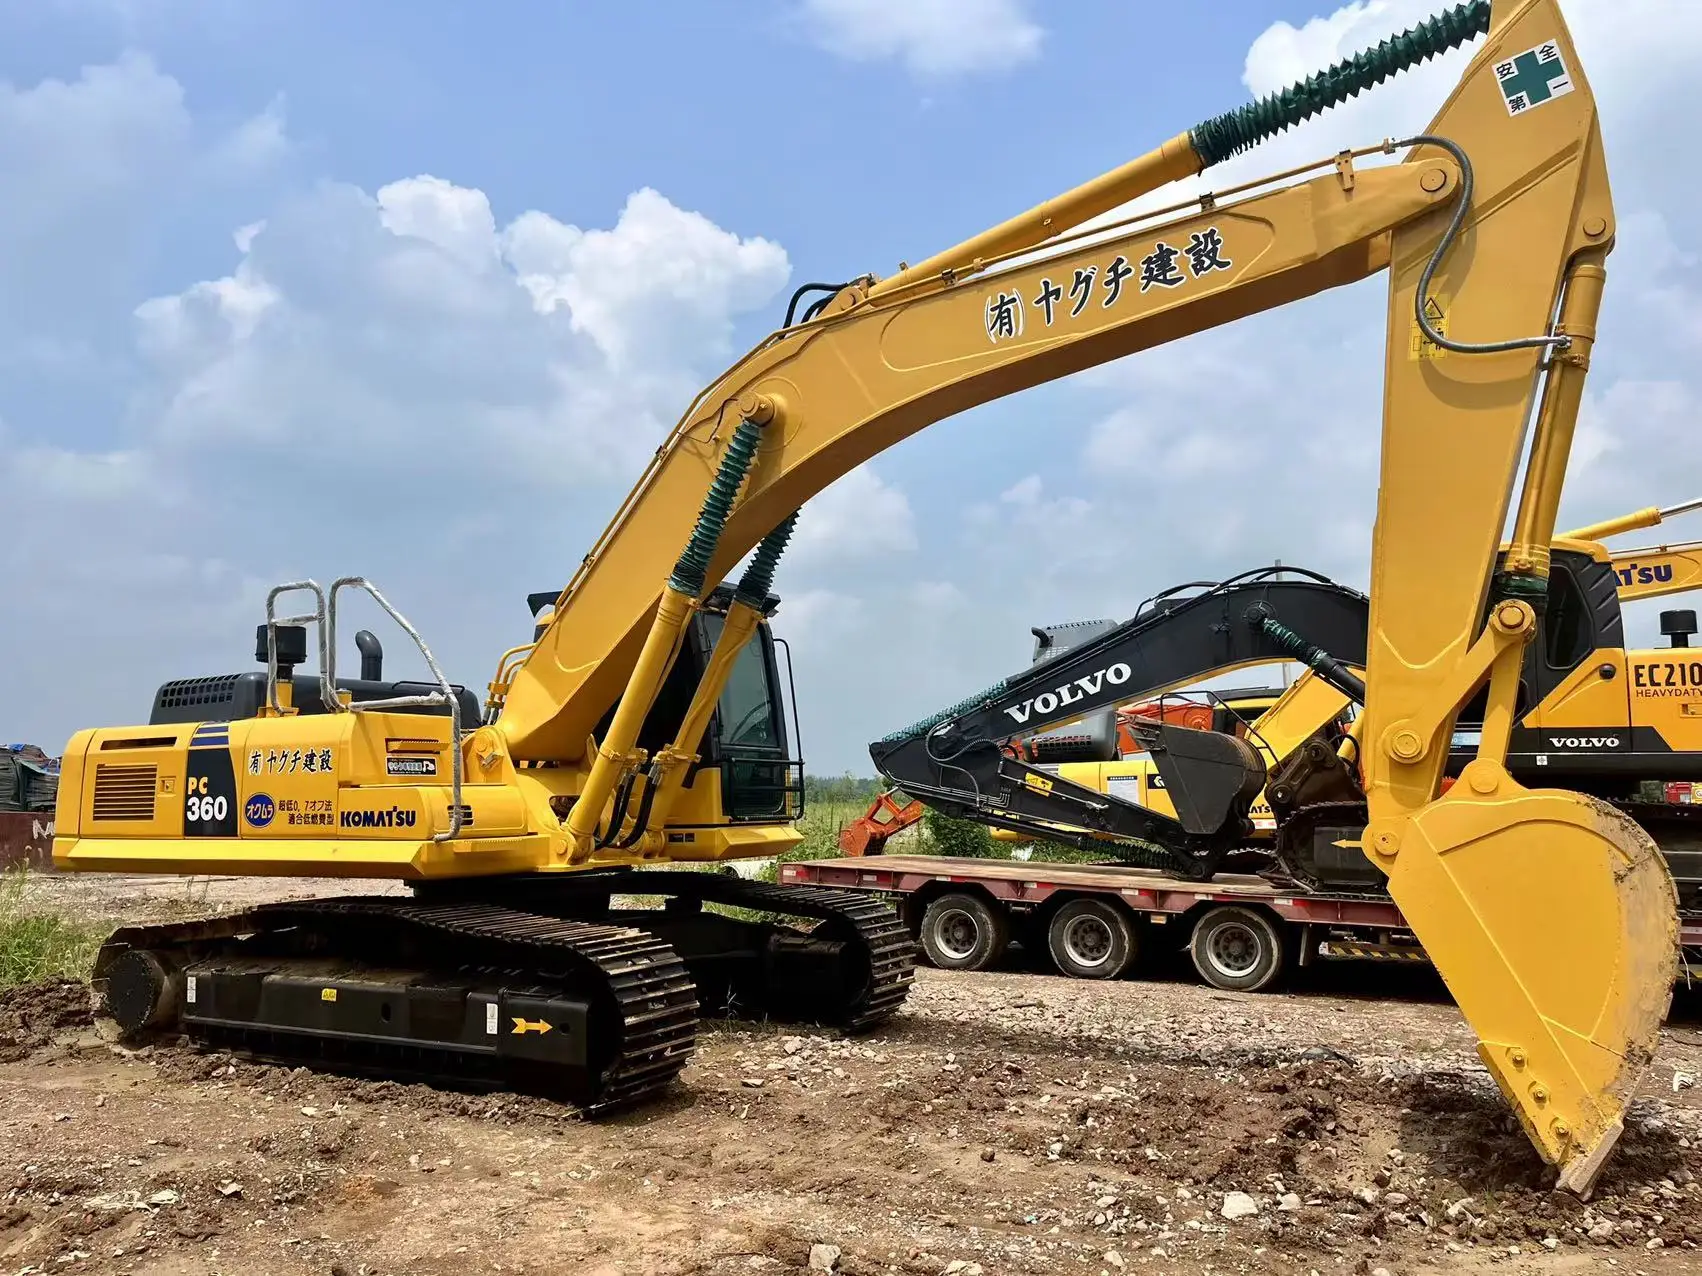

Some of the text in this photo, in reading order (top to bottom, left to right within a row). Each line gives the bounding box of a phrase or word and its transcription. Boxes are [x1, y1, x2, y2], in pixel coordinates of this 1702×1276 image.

[1003, 662, 1132, 724] VOLVO
[1549, 737, 1620, 748] VOLVO
[187, 776, 208, 794] PC
[186, 796, 228, 821] 360
[246, 803, 274, 819] オクムラ
[340, 805, 416, 827] KOMATSU
